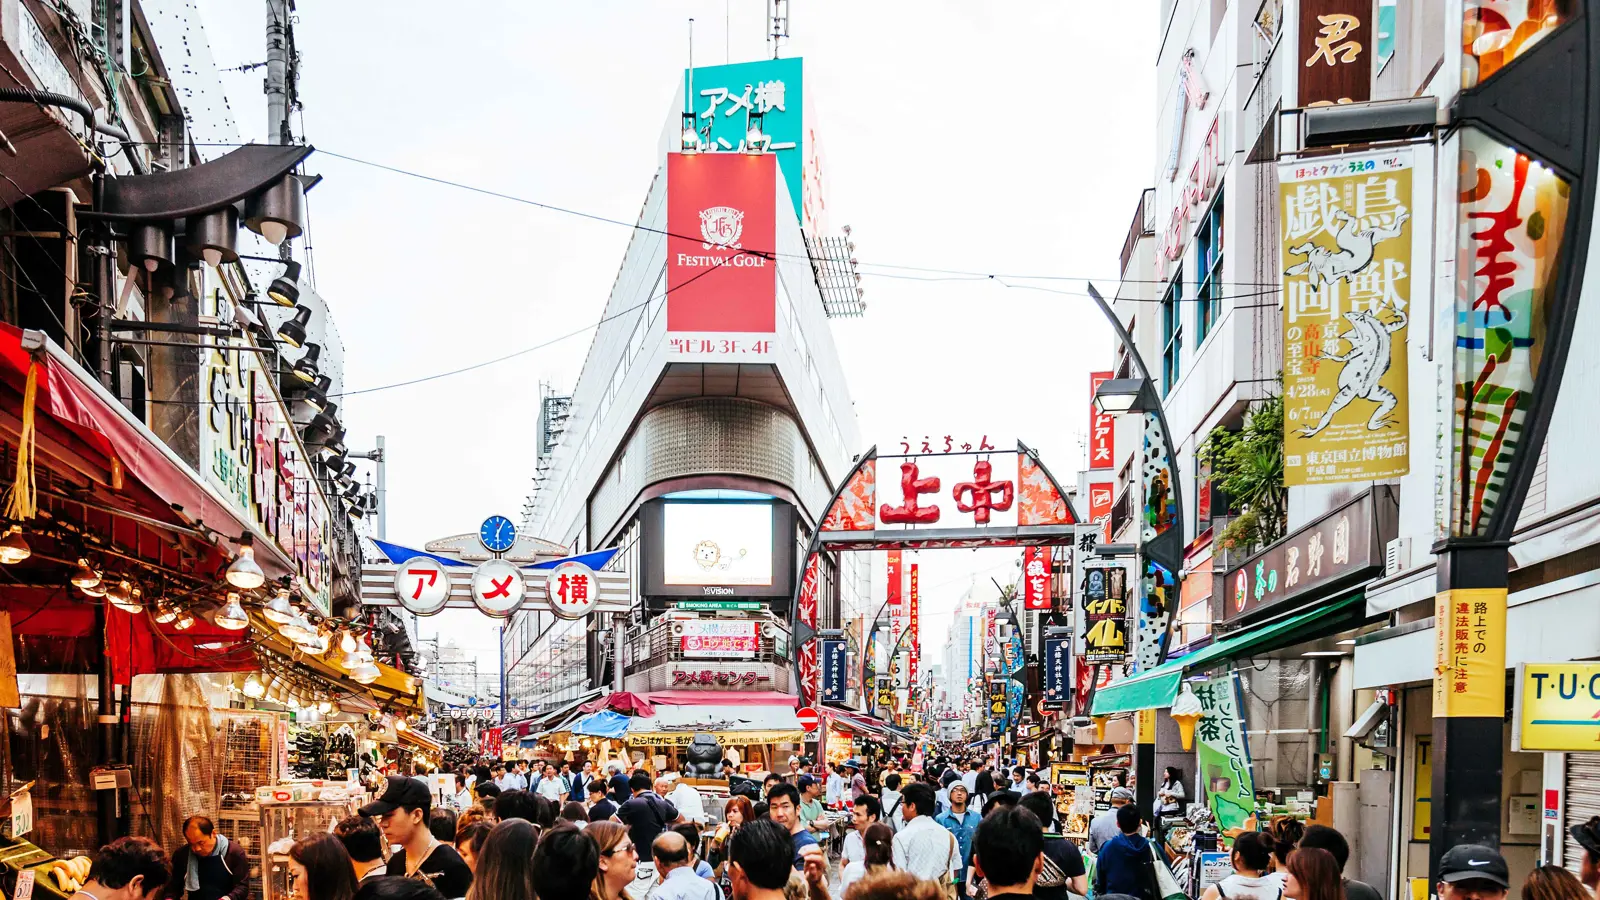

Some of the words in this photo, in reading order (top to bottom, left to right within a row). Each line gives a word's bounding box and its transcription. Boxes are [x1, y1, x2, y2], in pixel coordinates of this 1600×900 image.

[700, 80, 786, 119] アメ横
[1295, 160, 1375, 179] ほっとタウンうえの
[669, 339, 715, 354] 当ビル
[1286, 327, 1303, 376] の至宝
[1303, 323, 1321, 375] 高山寺
[1322, 321, 1340, 356] 京都
[900, 435, 995, 454] うえちゅん
[1306, 442, 1407, 465] 東京国立博物館
[879, 460, 1014, 524] 上中
[408, 568, 589, 605] アメ横
[1085, 598, 1125, 614] インドの
[1085, 618, 1125, 647] 仏
[1472, 602, 1487, 654] 路上での
[1454, 602, 1470, 694] 違法販売に注意
[672, 670, 770, 686] アメ横センター
[632, 736, 671, 745] たらばがに
